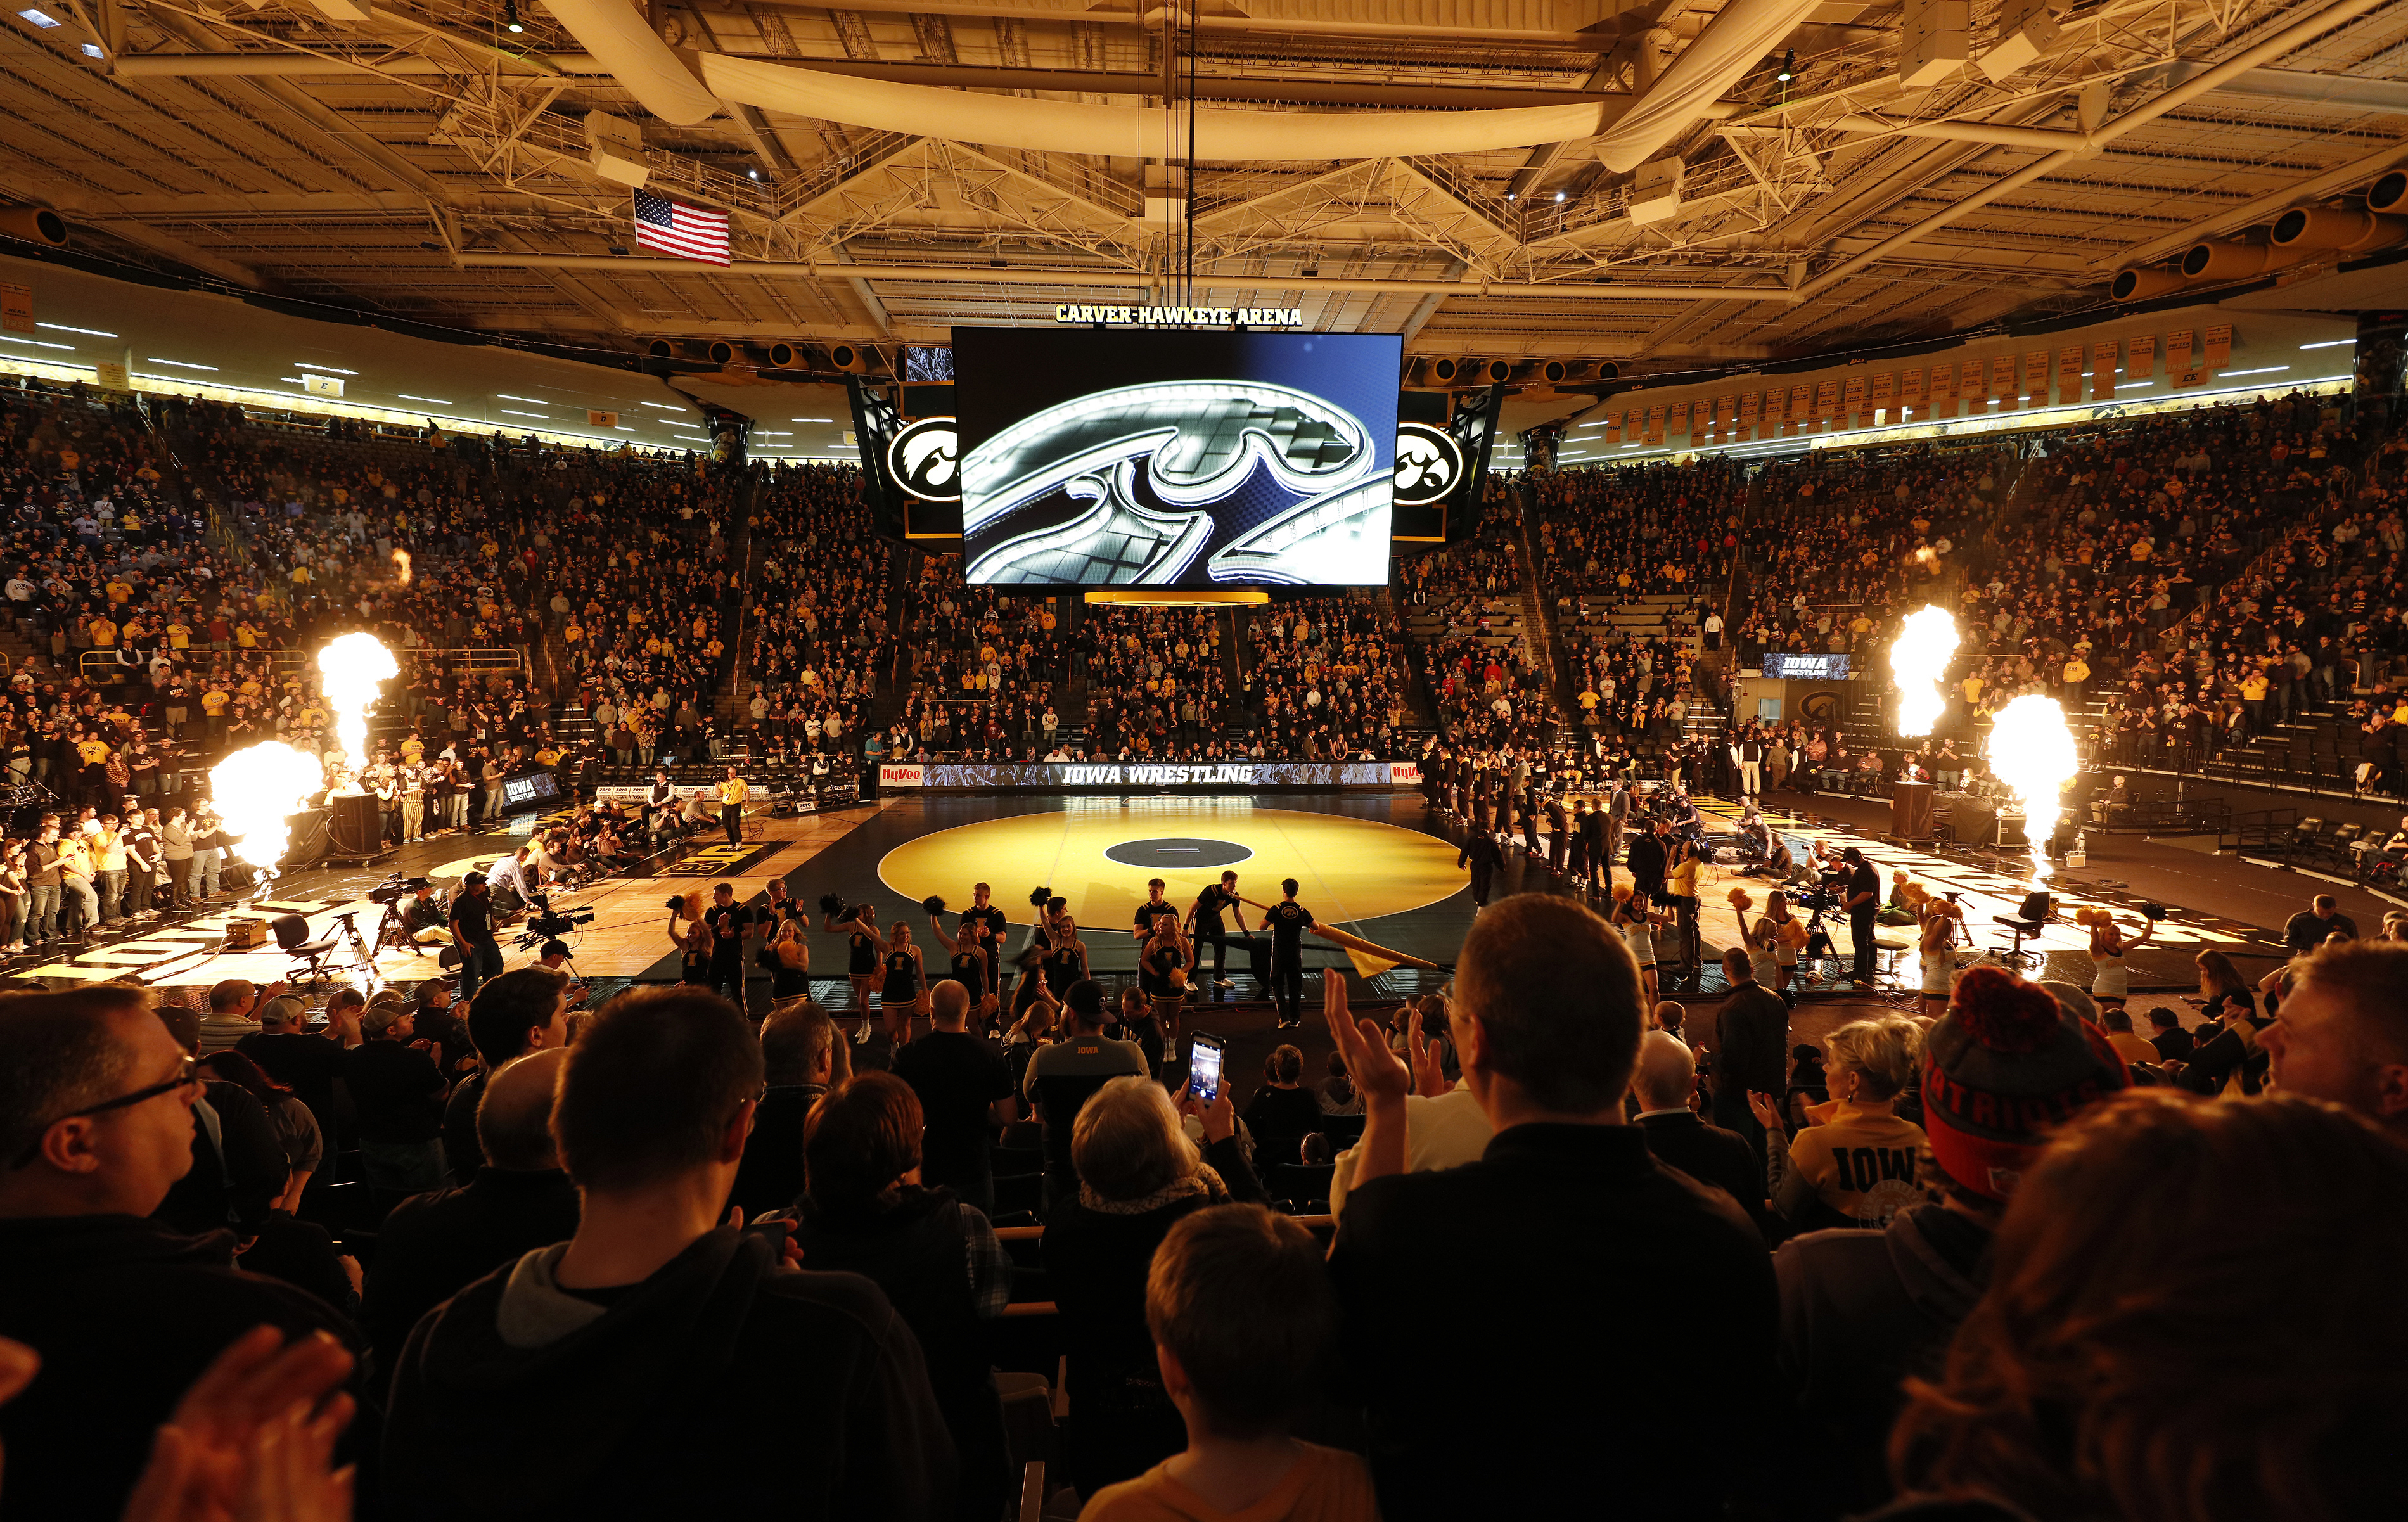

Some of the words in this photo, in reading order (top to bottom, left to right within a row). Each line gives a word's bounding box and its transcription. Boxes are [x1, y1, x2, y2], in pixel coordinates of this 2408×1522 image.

[1054, 305, 1232, 324] CARVER-HAWKEYE
[1235, 307, 1303, 327] ARENA
[2182, 373, 2198, 383] EE
[1783, 656, 1828, 669] IOWA
[81, 745, 101, 753] IOWA
[882, 769, 921, 783] HyVee
[1062, 765, 1122, 783] IOWA
[1128, 765, 1253, 783] WRESTLING
[505, 779, 535, 796] IOWA
[509, 791, 537, 802] WRESTLING
[1077, 1046, 1099, 1054] IOWA
[1926, 1066, 2098, 1130] ATRIOTS
[1832, 1146, 1924, 1192] IOW
